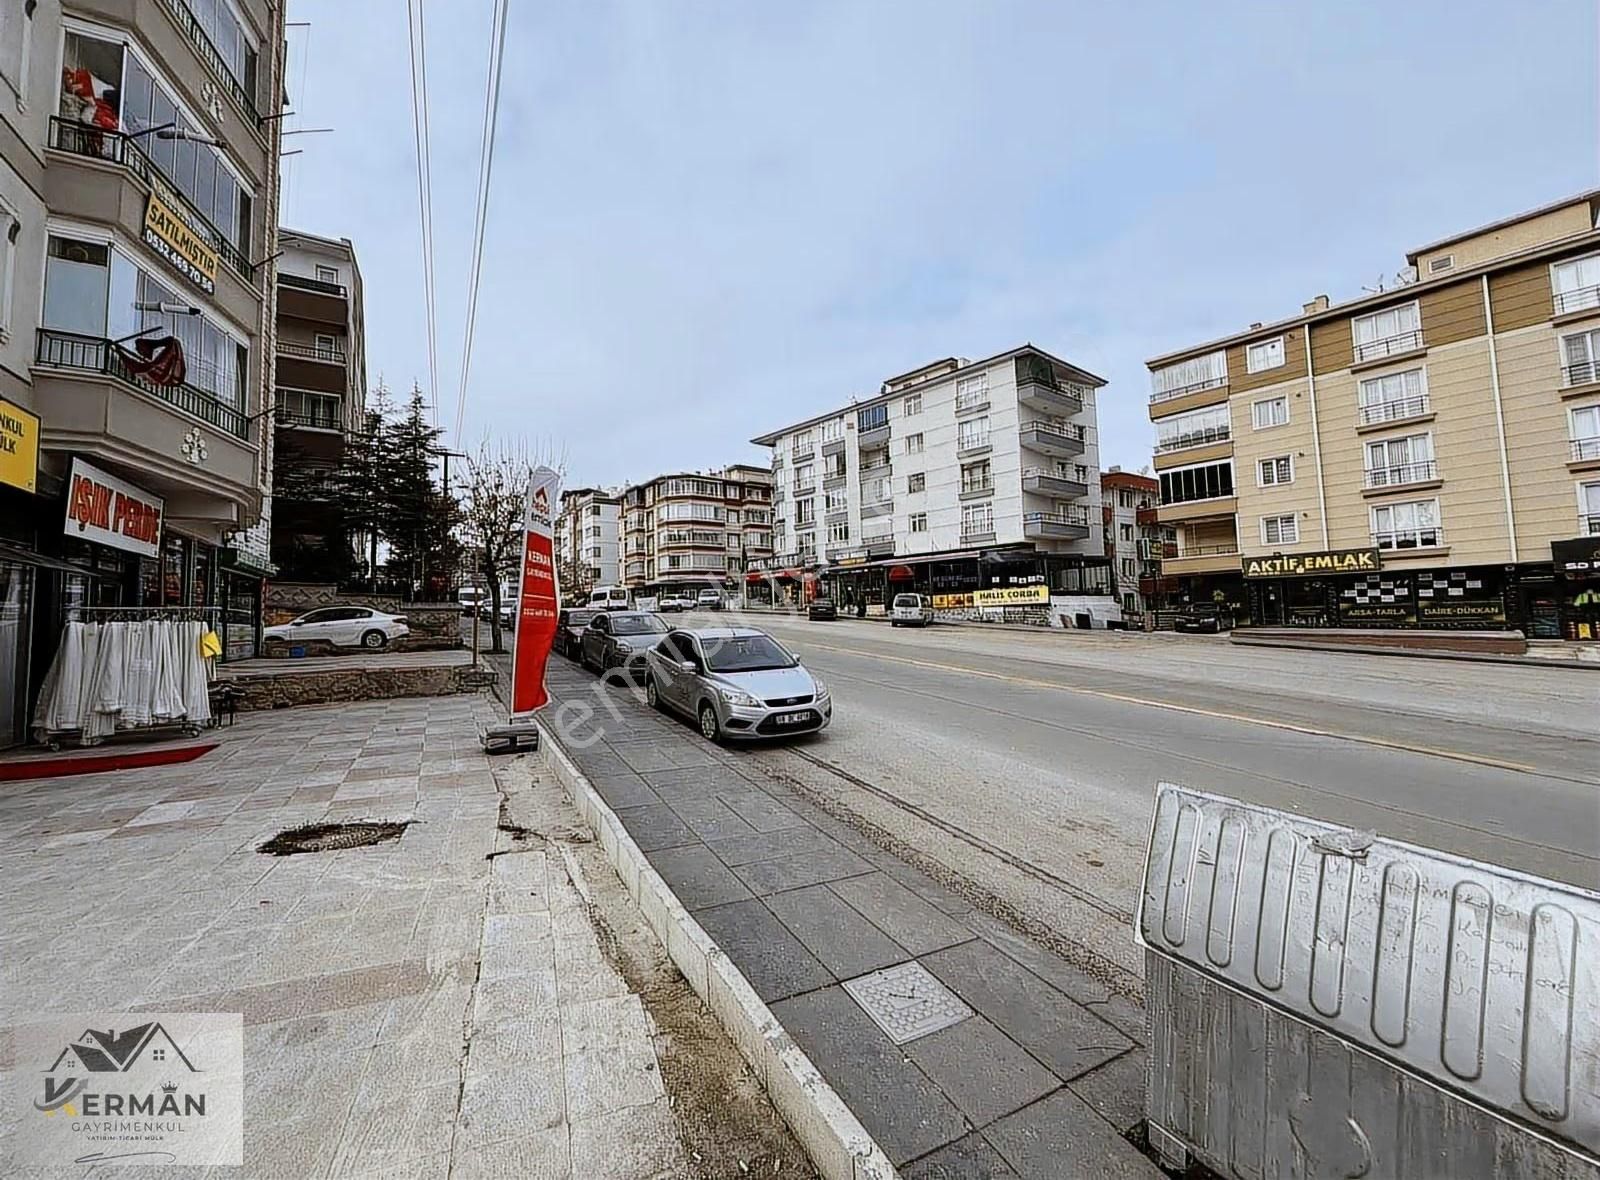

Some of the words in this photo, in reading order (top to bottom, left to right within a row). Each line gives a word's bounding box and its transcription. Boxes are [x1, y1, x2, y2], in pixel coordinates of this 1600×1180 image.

[148, 204, 215, 274] SATILMIŞTIR
[1247, 556, 1299, 573] AKTİF
[1304, 552, 1374, 569] EMLAK
